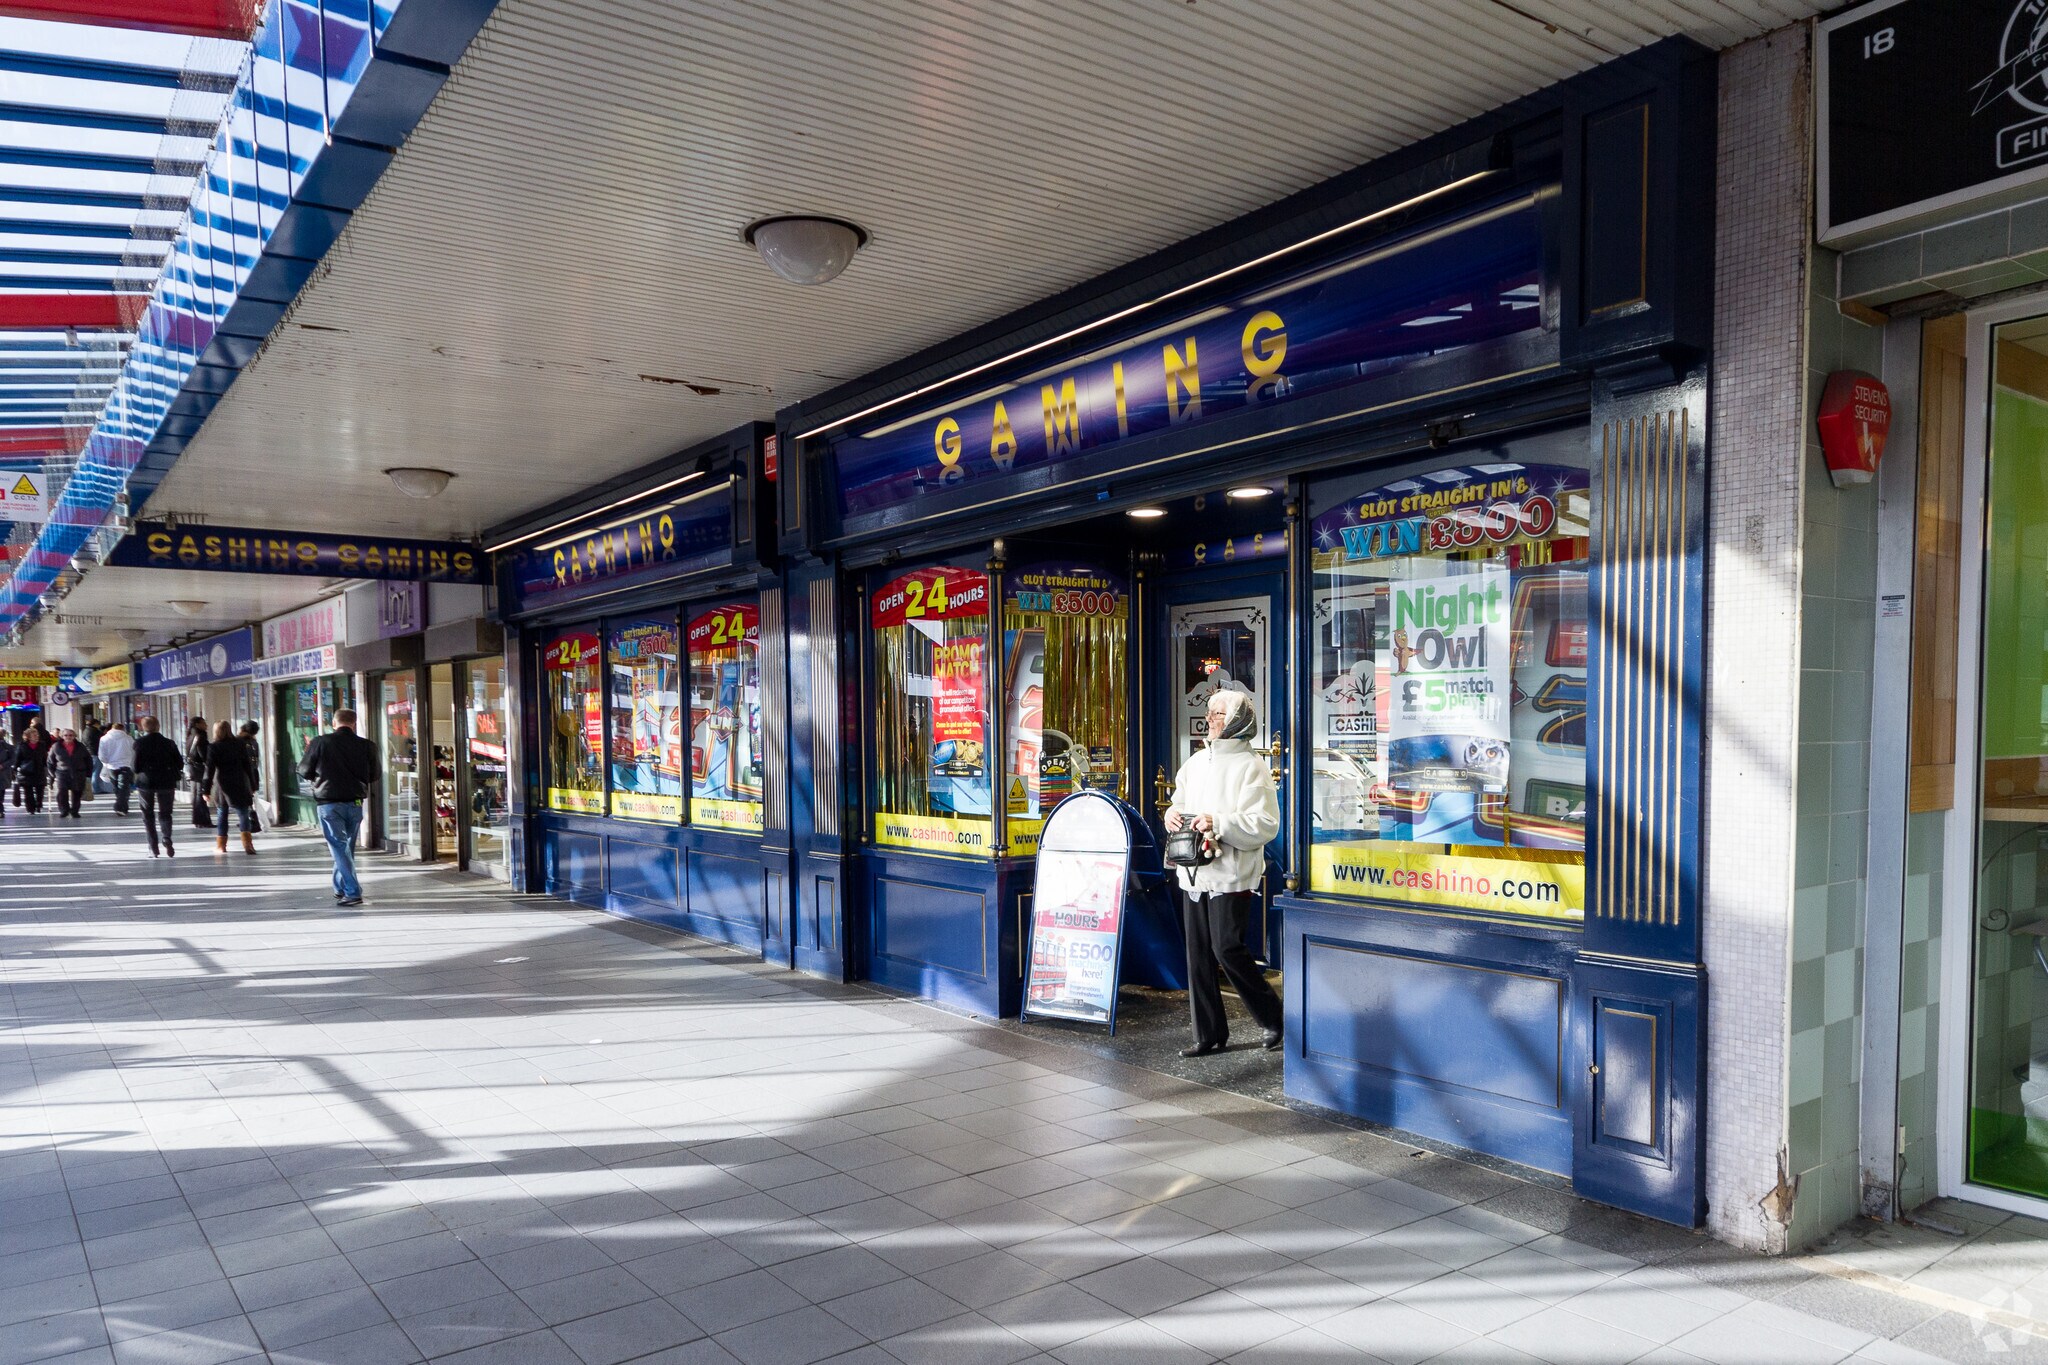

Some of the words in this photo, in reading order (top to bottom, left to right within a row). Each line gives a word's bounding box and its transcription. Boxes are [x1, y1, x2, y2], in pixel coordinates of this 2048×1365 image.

[934, 310, 1288, 468] GAMING
[1855, 385, 1887, 407] STEVENS
[1855, 404, 1887, 424] SECURITY
[1359, 499, 1397, 520] SLOT
[1400, 485, 1486, 514] STRAIGHT
[1492, 479, 1512, 496] IN
[1515, 477, 1529, 494] &
[1339, 515, 1427, 562] WIN
[1429, 494, 1556, 551] £500
[147, 532, 319, 562] CASHINO
[337, 543, 474, 571] GAMING
[553, 513, 675, 580] CASHINO
[1023, 574, 1045, 586] SLOT
[1046, 575, 1089, 588] STRAIGHT
[1090, 578, 1101, 589] IN
[1101, 578, 1109, 589] &
[880, 591, 904, 612] OPEN
[905, 576, 949, 618] 24
[949, 585, 984, 609] HOURS
[1016, 590, 1053, 611] WIN
[1054, 590, 1115, 616] £500
[1396, 579, 1503, 638] Night
[690, 623, 710, 640] OPEN
[711, 612, 745, 645] 24
[546, 647, 560, 660] OPEN
[559, 639, 581, 664] 24
[581, 645, 599, 660] HOURS
[618, 639, 639, 657] WIN
[640, 635, 667, 656] £500
[933, 642, 980, 661] PROMO
[1416, 625, 1486, 670] Owl
[21, 671, 58, 679] PALACE
[186, 648, 210, 681] Hospice
[934, 660, 979, 679] MATCH
[1402, 679, 1447, 713] £5
[1445, 677, 1494, 694] match
[477, 713, 498, 734] SALE
[1041, 758, 1066, 772] OPEN
[1426, 769, 1467, 777] CANO
[618, 800, 676, 815] www.cashino.com
[885, 825, 982, 845] www.cashino.com
[1332, 863, 1560, 903] www.cashino.com
[1055, 912, 1100, 928] HOURS
[1070, 943, 1112, 961] £500
[1082, 968, 1103, 979] here!
